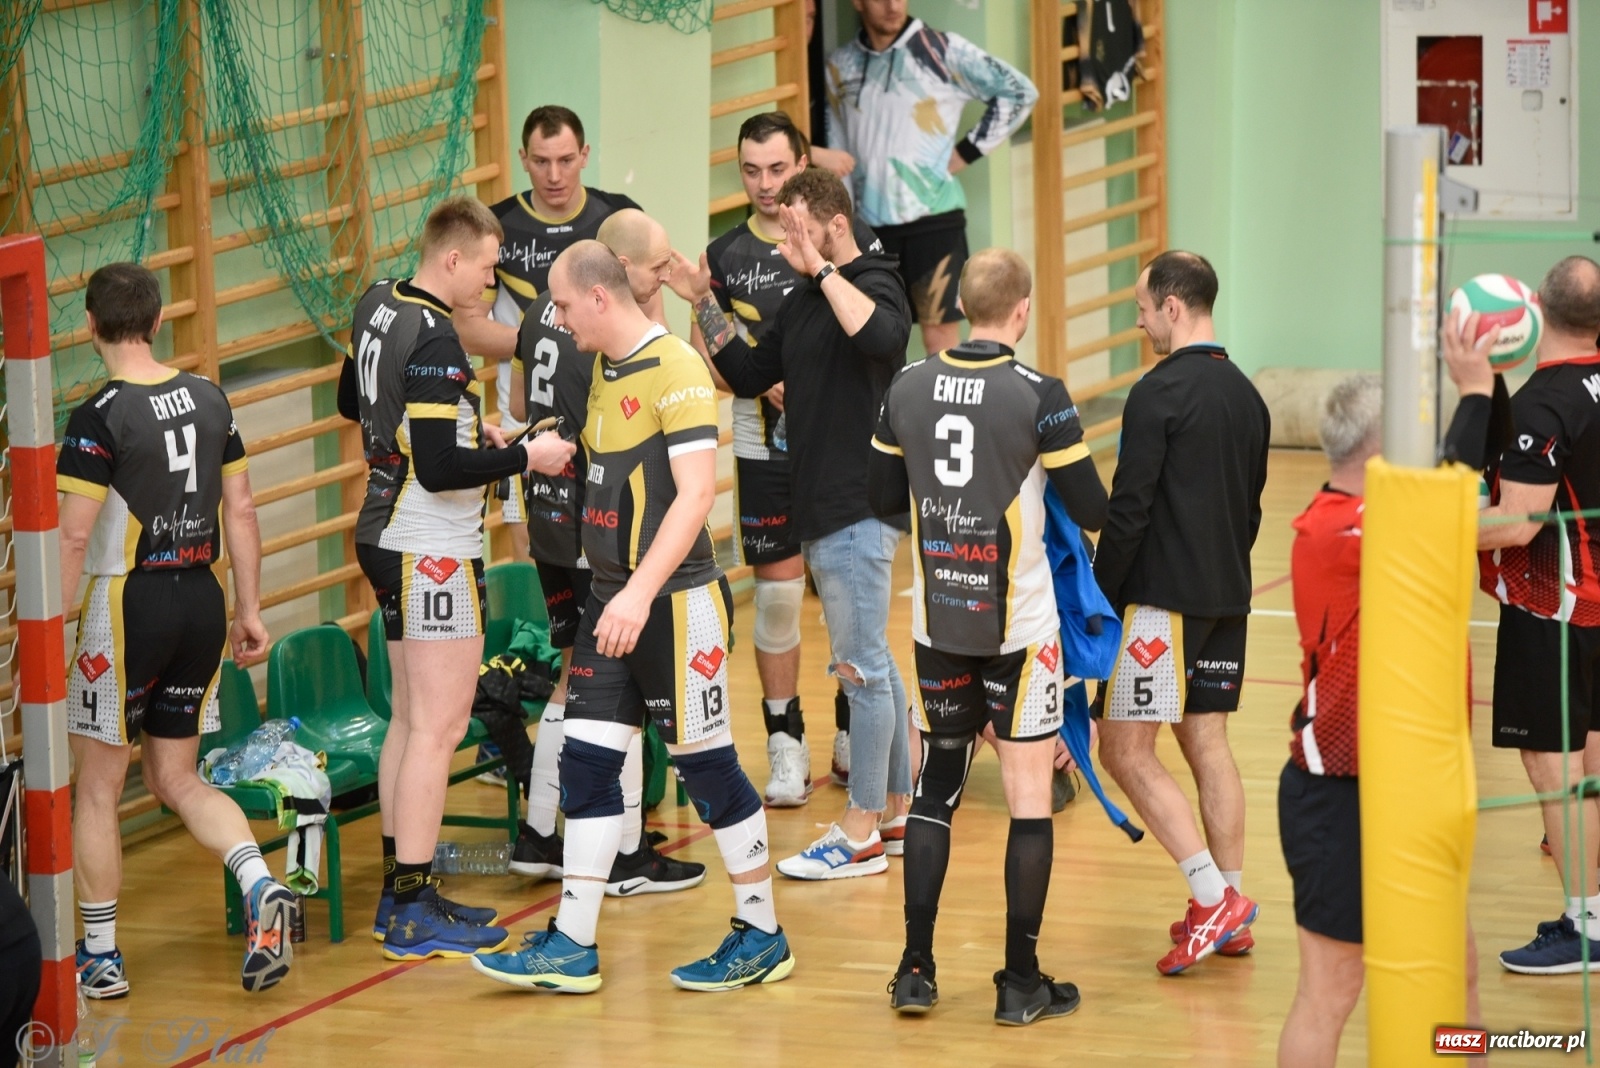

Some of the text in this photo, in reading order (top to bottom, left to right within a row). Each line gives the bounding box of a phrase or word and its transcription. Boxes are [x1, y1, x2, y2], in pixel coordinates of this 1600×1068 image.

[520, 238, 557, 272] Hair
[745, 262, 780, 295] Hair
[358, 330, 382, 405] 10
[530, 336, 559, 408] 2
[149, 386, 197, 421] ENTER
[933, 374, 985, 405] ENTER
[164, 423, 198, 493] 4
[934, 413, 975, 488] 3
[944, 497, 982, 535] Hair
[424, 591, 453, 621] 10
[696, 654, 716, 671] Enter
[1134, 640, 1153, 661] Enter
[82, 690, 98, 722] 4
[701, 685, 723, 721] 13
[1045, 682, 1058, 714] 3
[1133, 676, 1154, 707] 5
